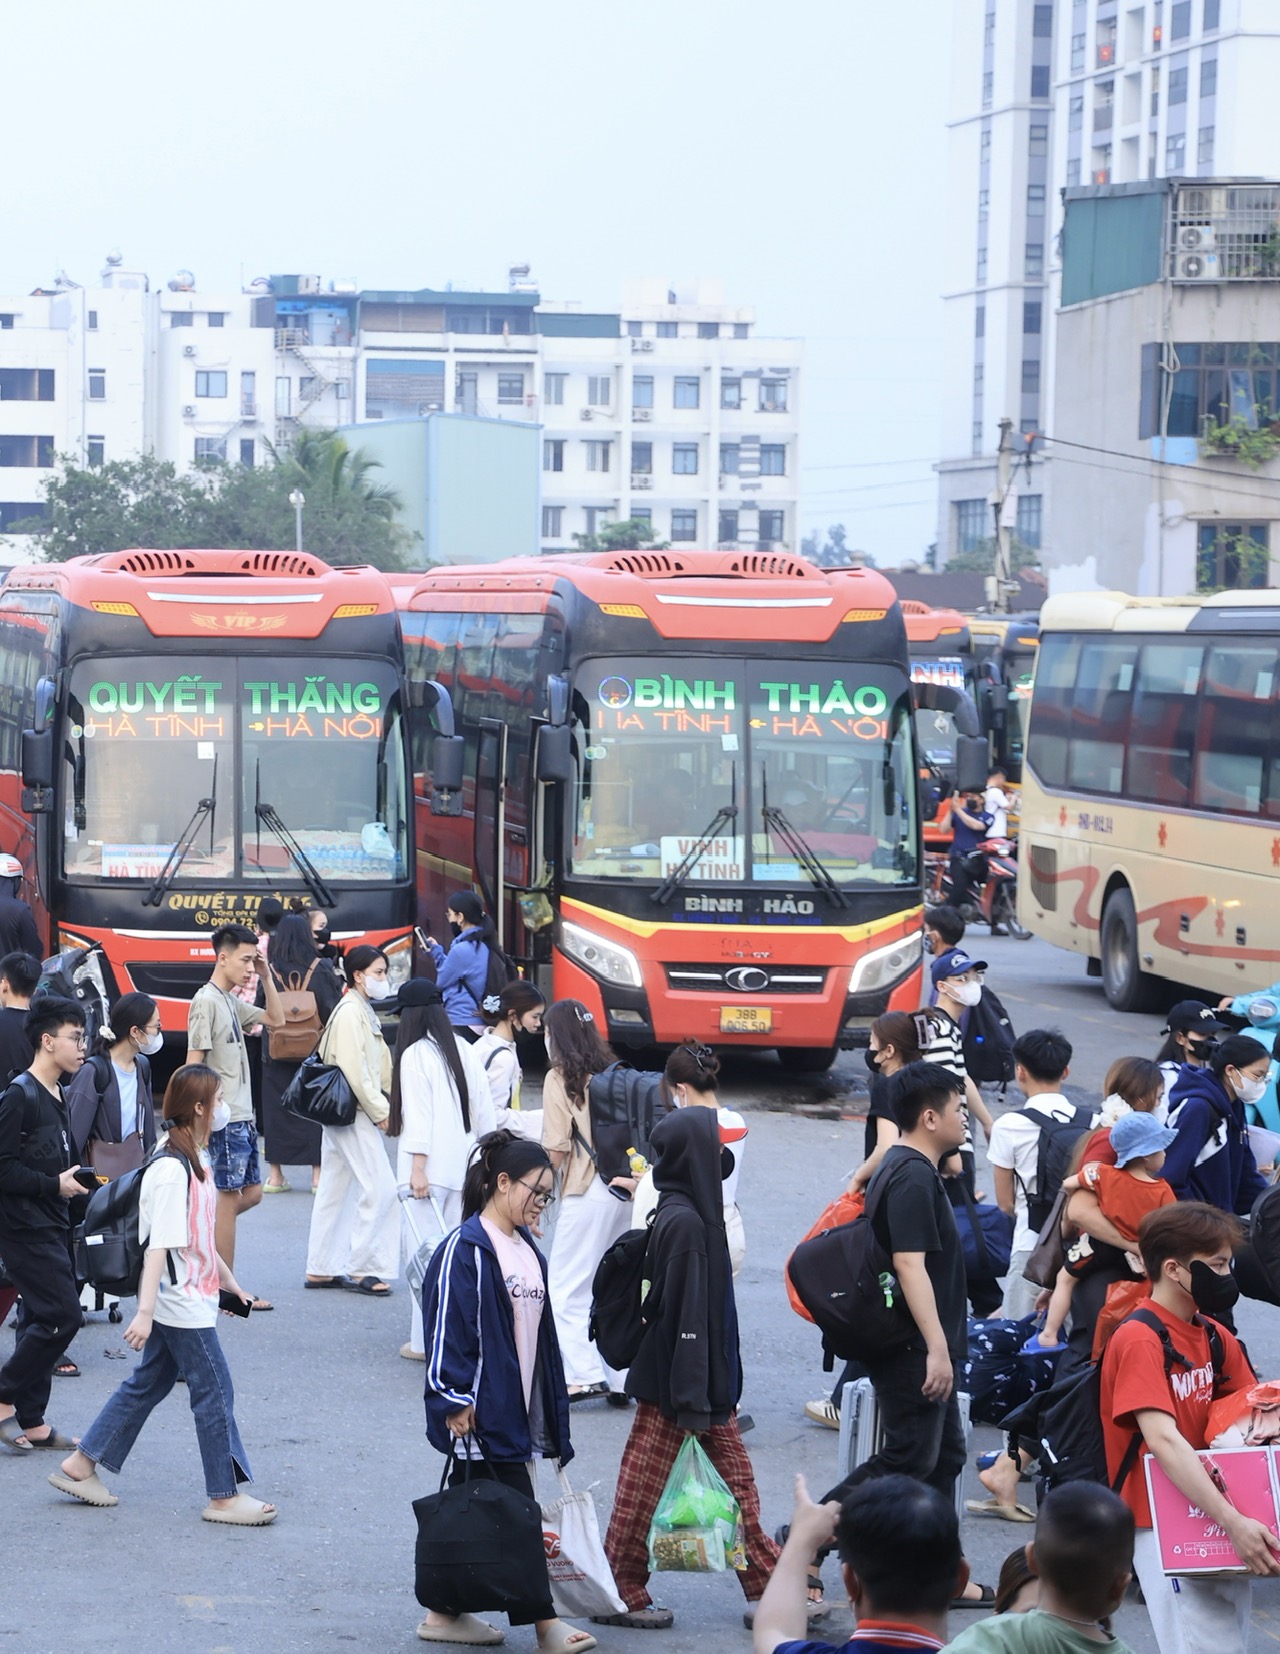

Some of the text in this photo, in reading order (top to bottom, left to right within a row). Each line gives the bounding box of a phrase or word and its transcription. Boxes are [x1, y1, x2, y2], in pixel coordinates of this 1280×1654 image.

[223, 615, 257, 628] VIP
[88, 675, 381, 714] QUYẾT THẮNG
[634, 674, 887, 716] BÌNH THẢO
[89, 713, 382, 740] HÀ TĨNH HÀ NỘI
[697, 860, 740, 879] TĨNH
[169, 891, 238, 910] QUYẾT
[684, 894, 743, 912] BÌNH
